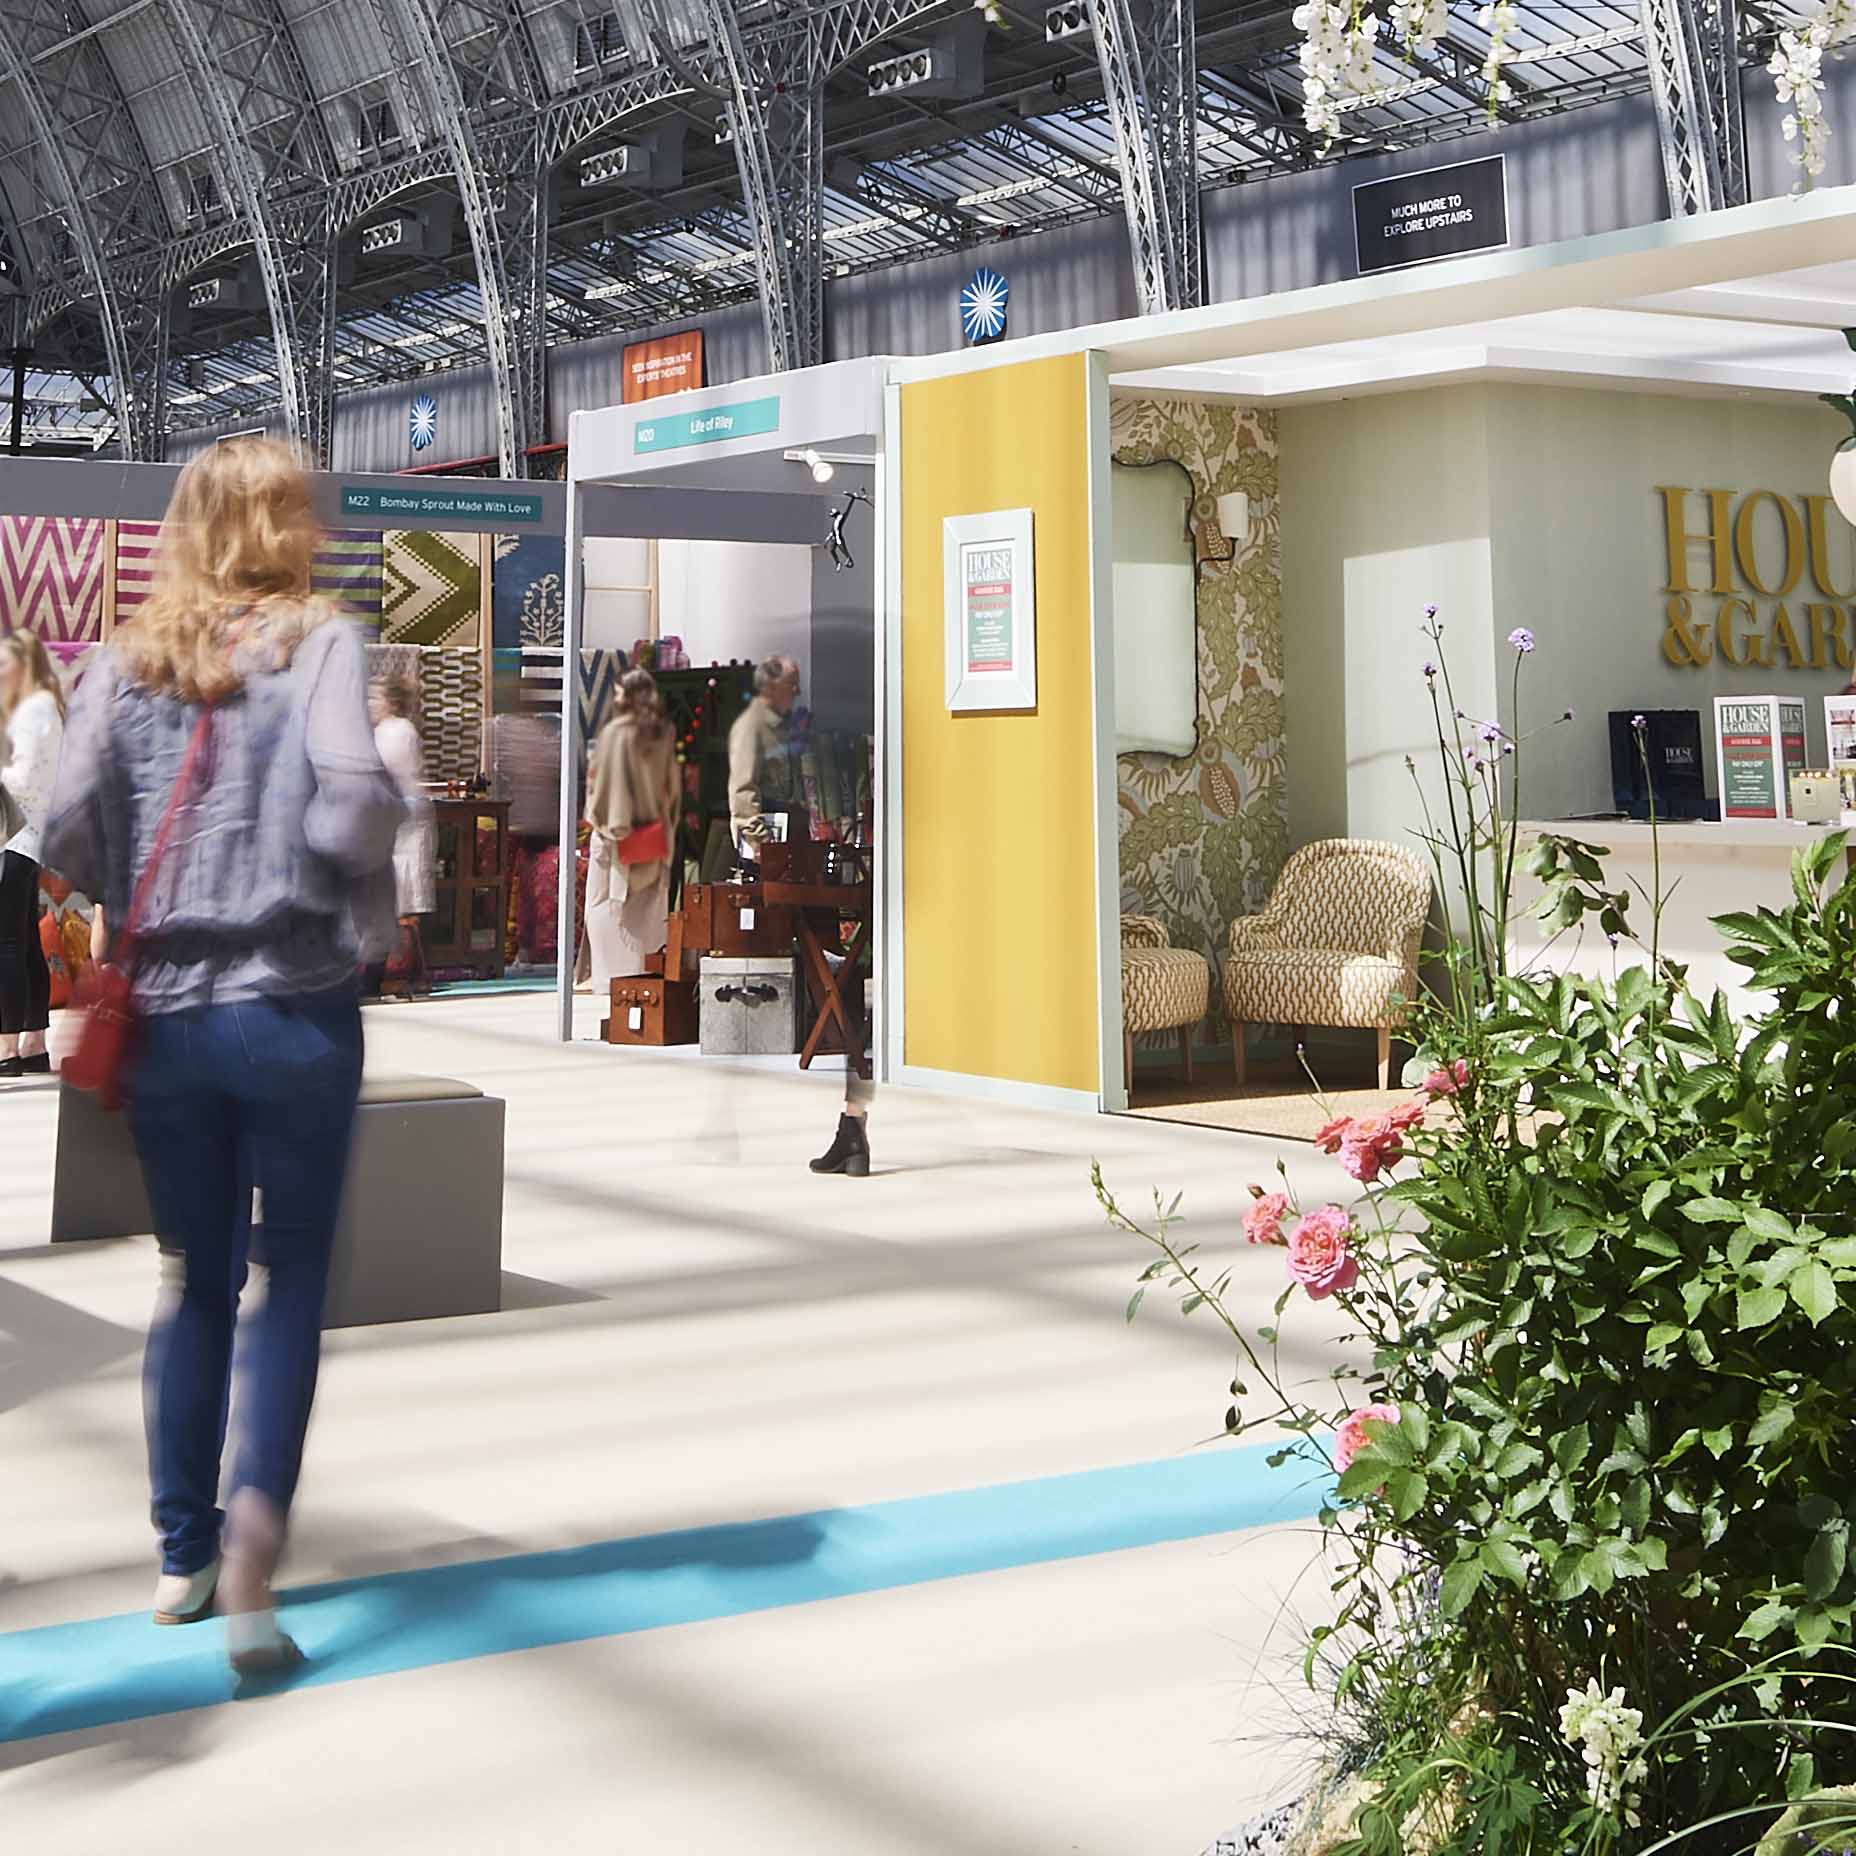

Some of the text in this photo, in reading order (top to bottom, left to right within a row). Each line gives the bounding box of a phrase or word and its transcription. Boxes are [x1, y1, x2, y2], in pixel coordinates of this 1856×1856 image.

[1391, 194, 1462, 219] MUCH MORE TO
[1383, 209, 1473, 237] EXPLORE UPSTAIRS
[690, 415, 734, 434] Life of Riley
[348, 495, 531, 514] M22 Bombay Sprout Made With Love
[1722, 705, 1769, 723] HOUSE
